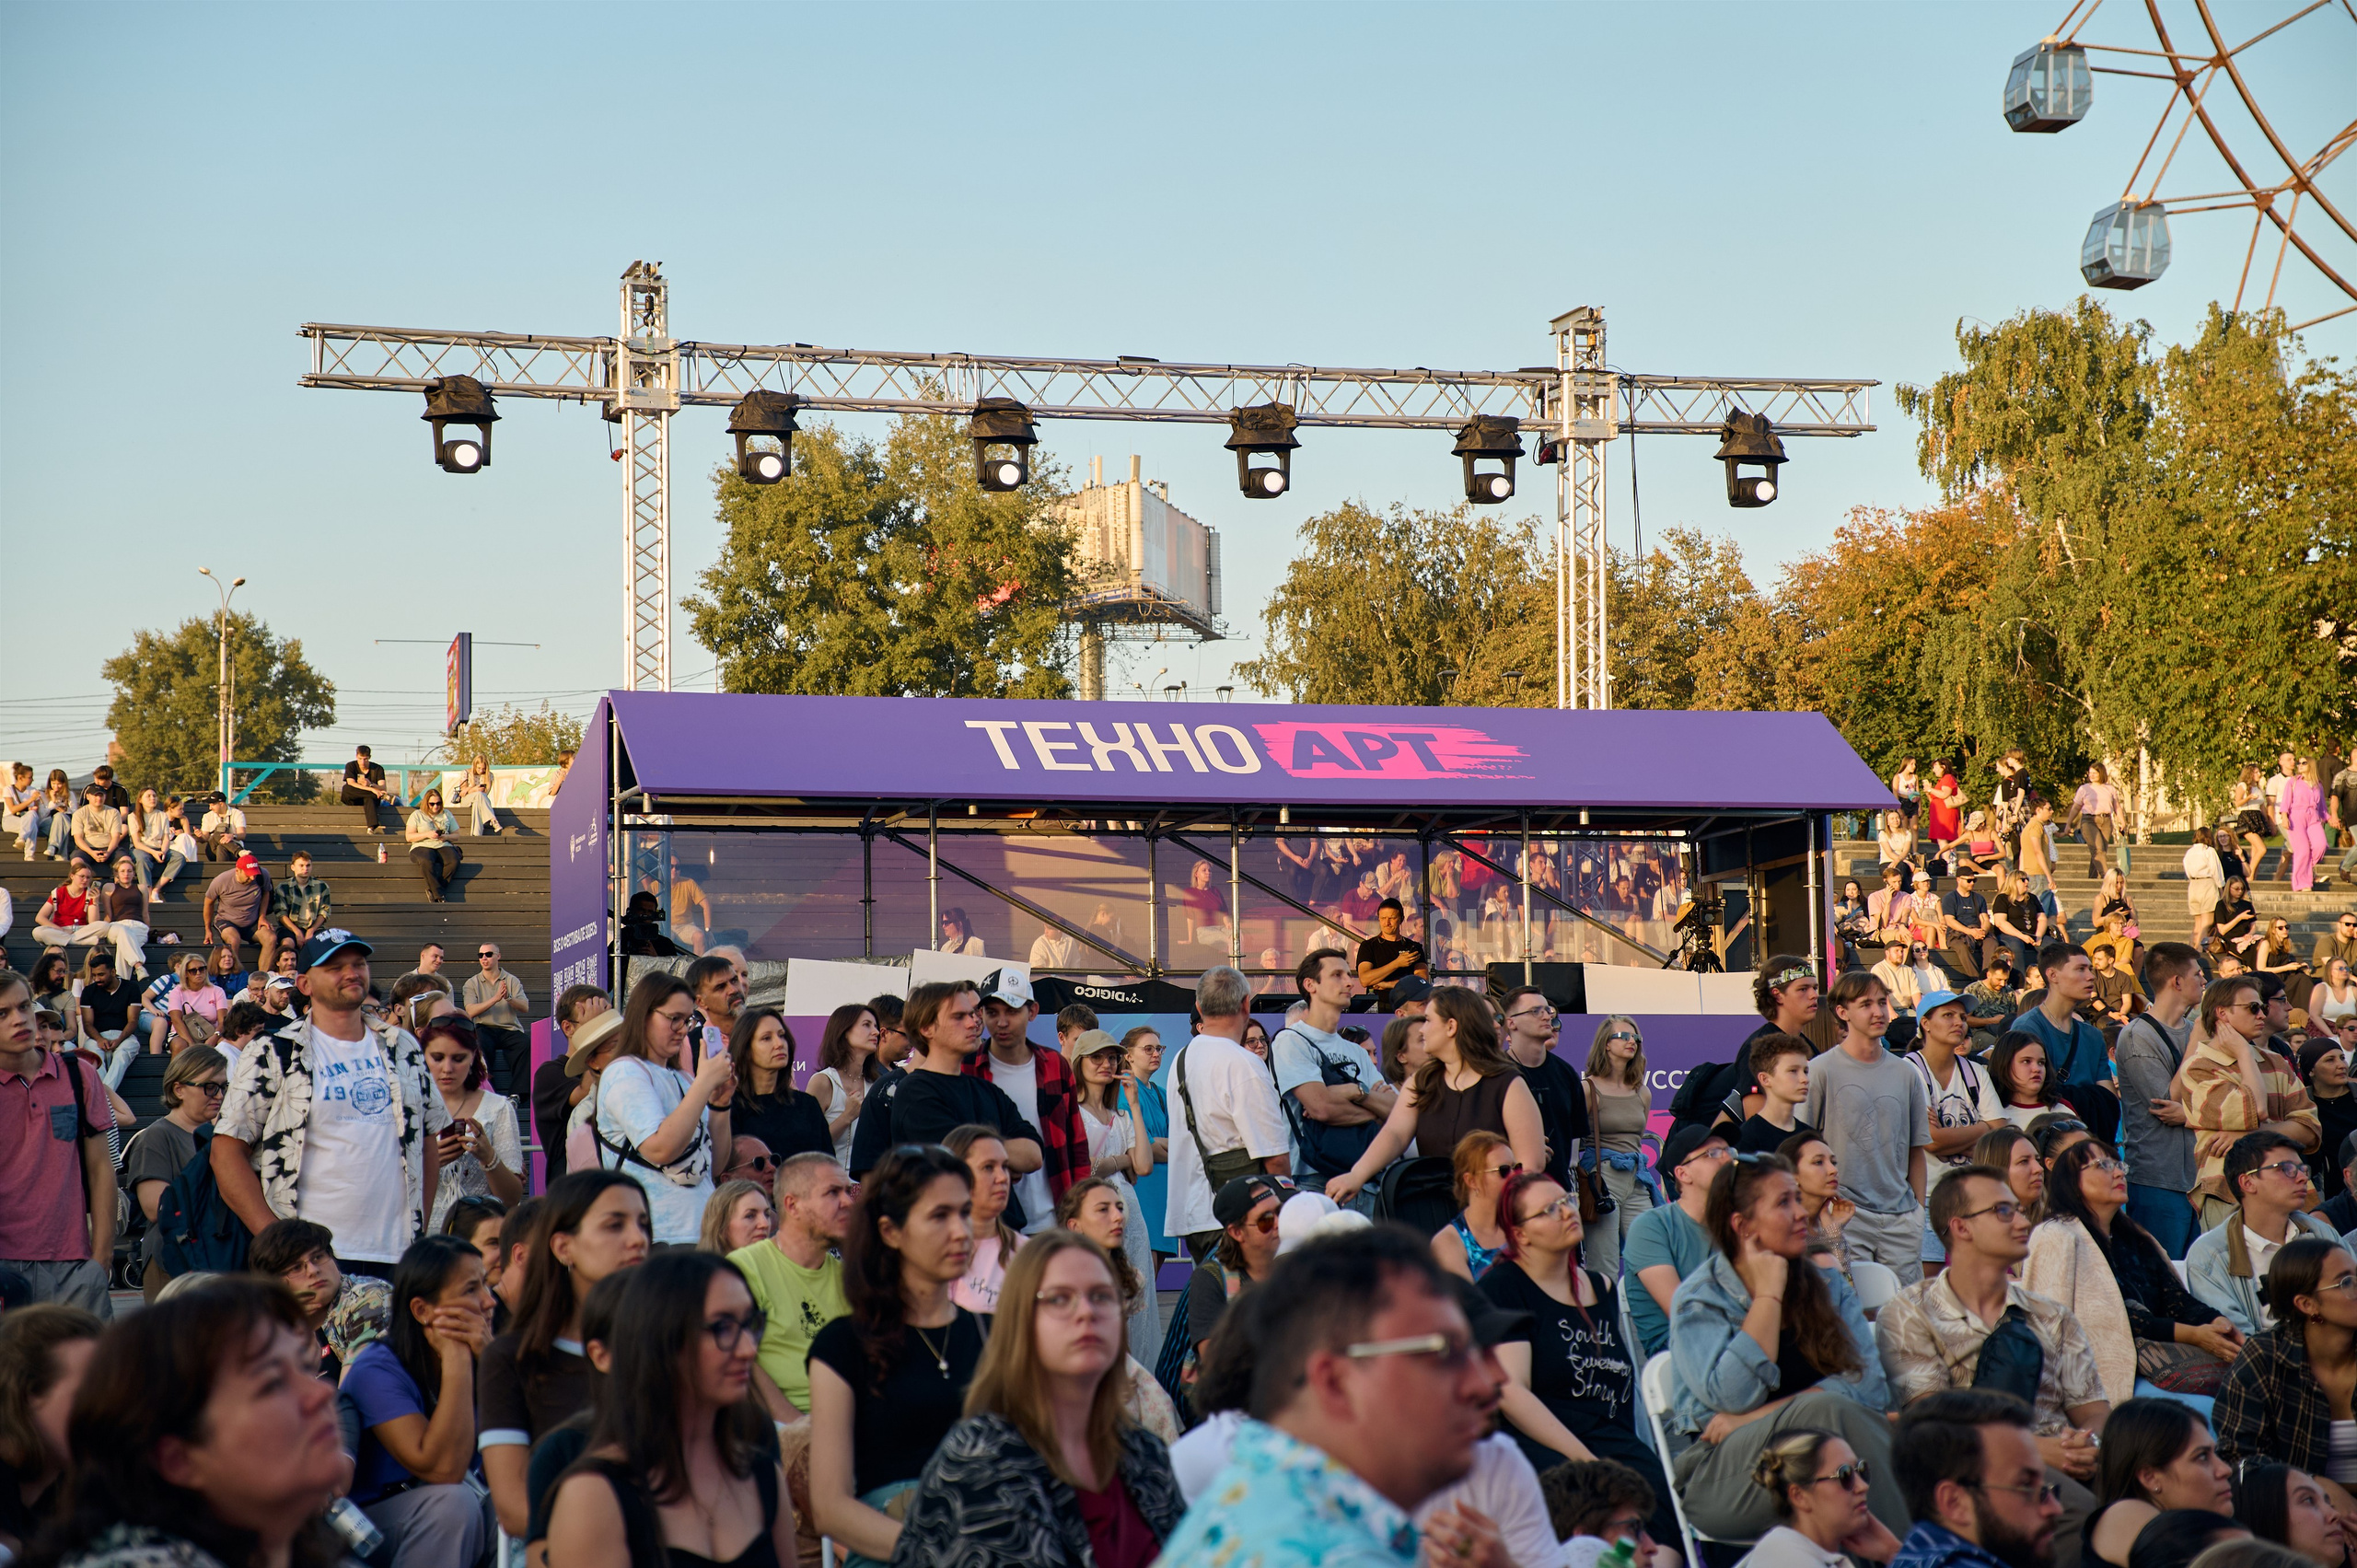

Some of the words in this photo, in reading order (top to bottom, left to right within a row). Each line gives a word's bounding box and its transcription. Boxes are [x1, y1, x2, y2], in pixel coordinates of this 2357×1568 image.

[964, 720, 1261, 774] ТЕХНО
[1292, 730, 1447, 772] АРТ
[1557, 1318, 1616, 1347] South
